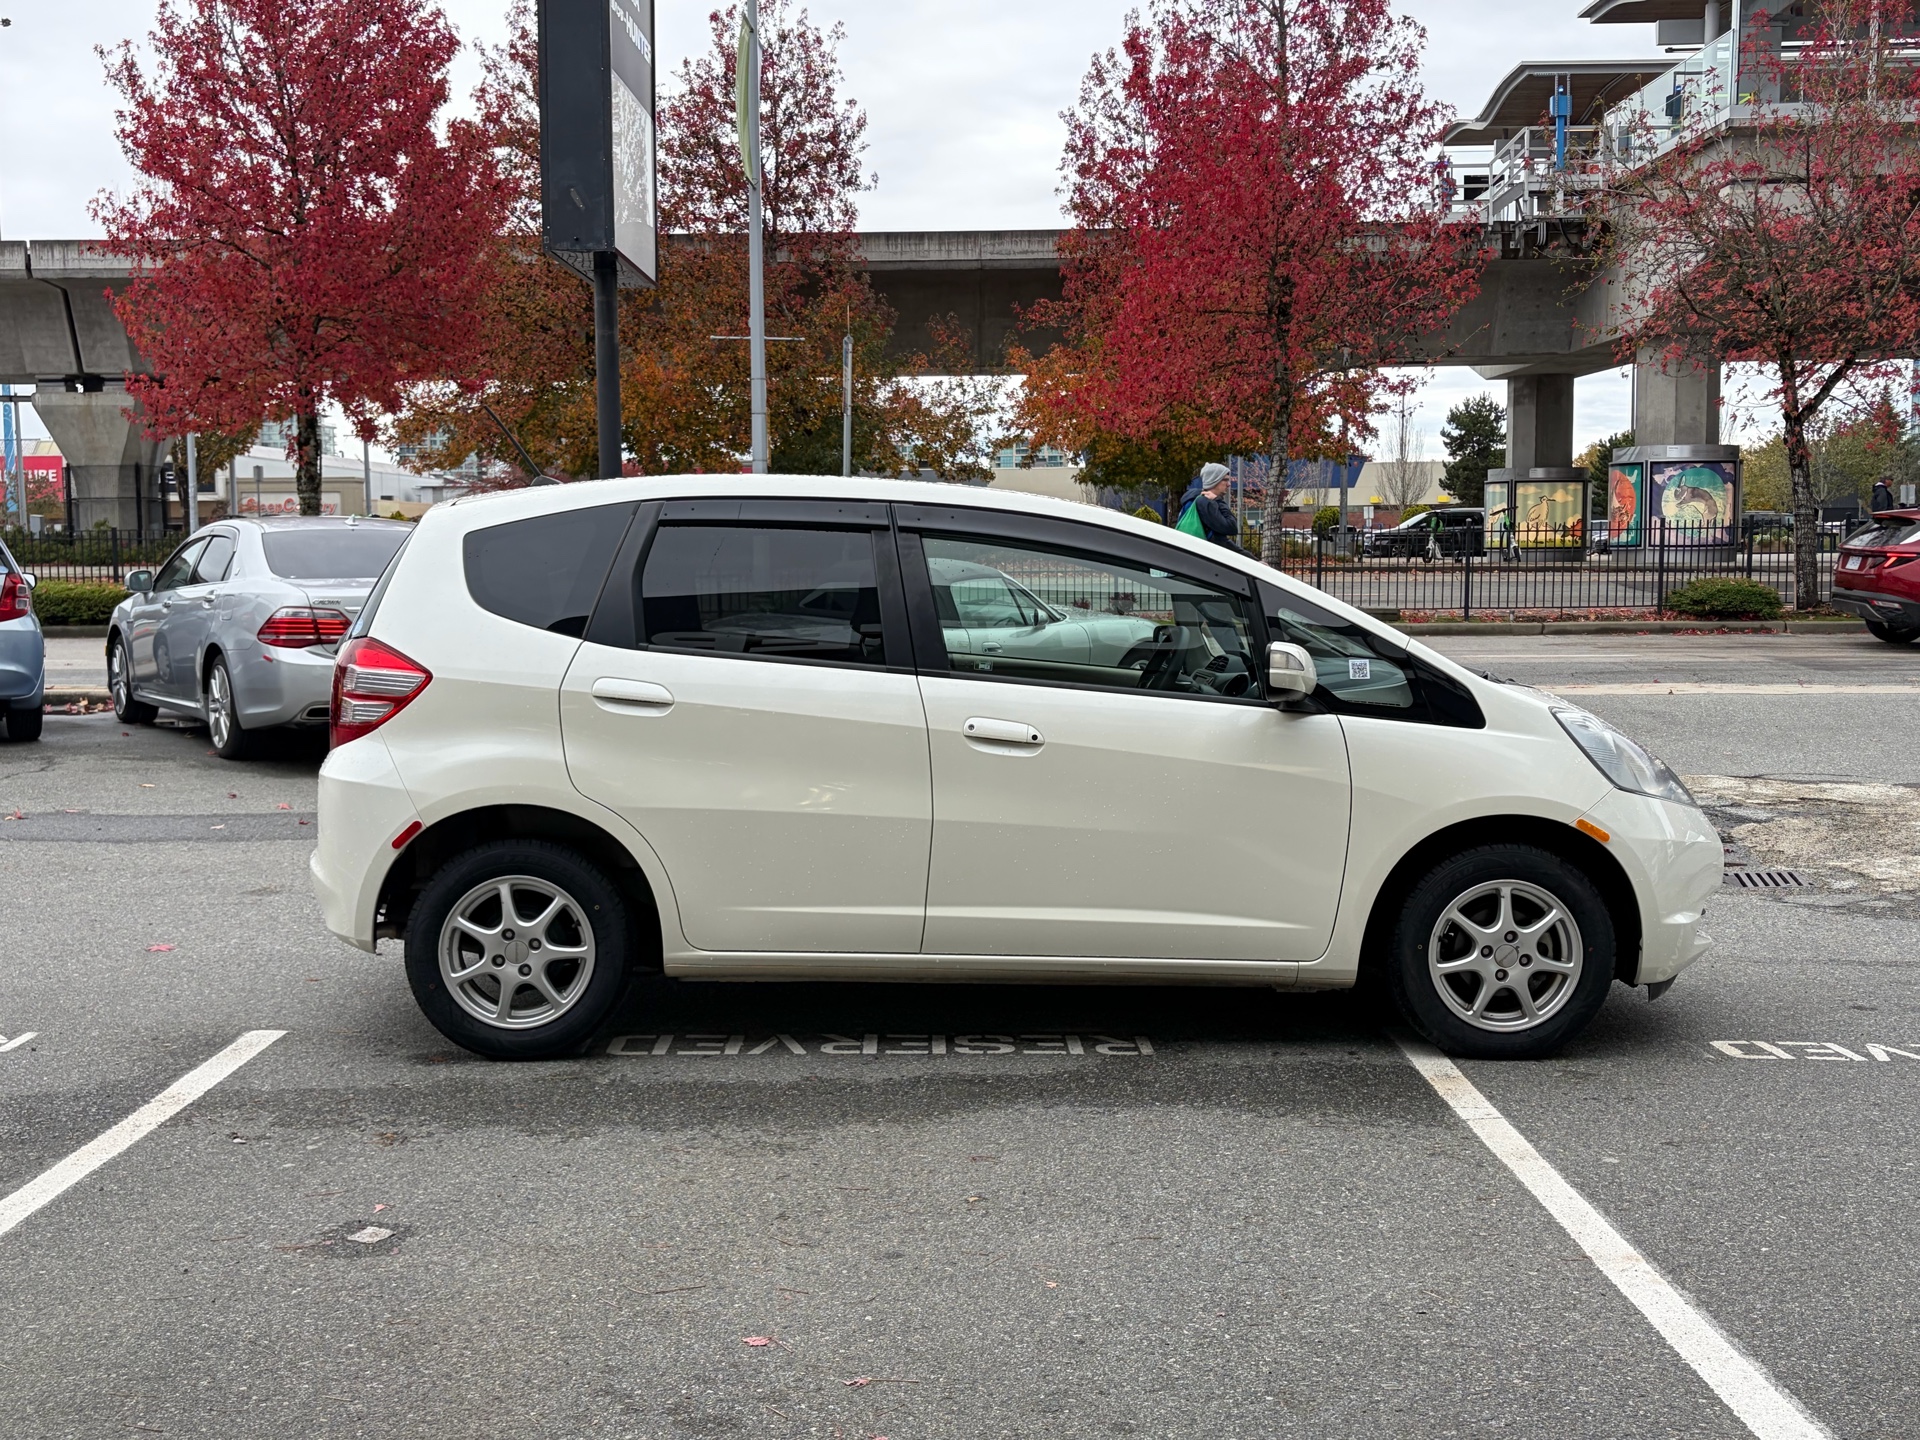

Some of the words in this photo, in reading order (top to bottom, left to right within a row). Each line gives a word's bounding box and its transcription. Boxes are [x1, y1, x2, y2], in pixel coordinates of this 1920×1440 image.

[312, 598, 342, 606] CROWN
[604, 1033, 1156, 1056] RESERVED
[1709, 1040, 1920, 1062] VED
